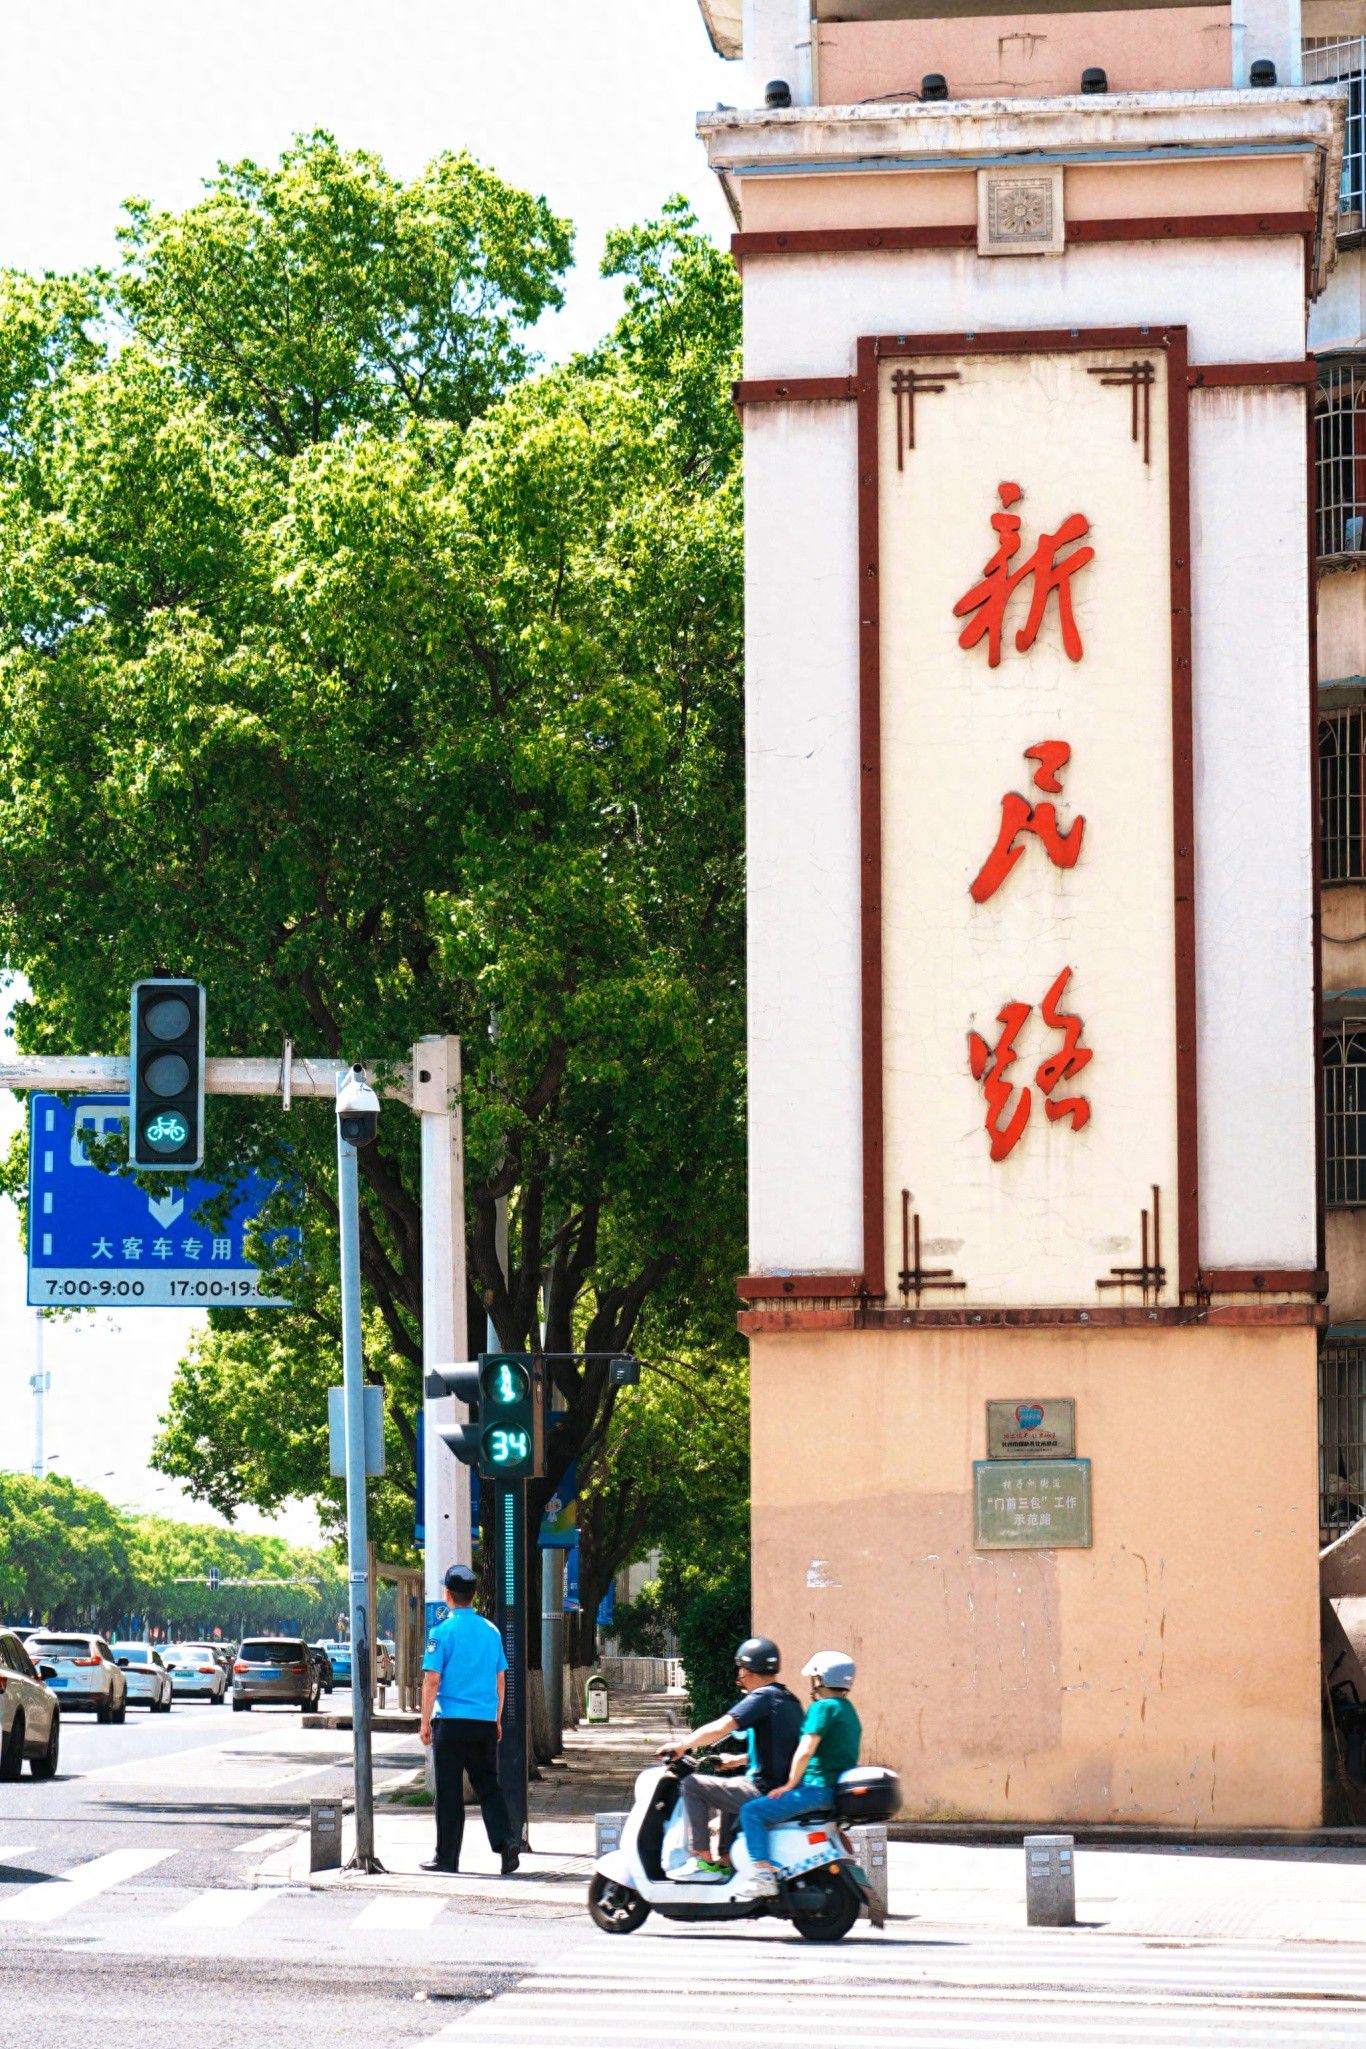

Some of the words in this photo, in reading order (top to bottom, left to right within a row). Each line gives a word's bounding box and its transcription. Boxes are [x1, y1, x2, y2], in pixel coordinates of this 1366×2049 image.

[953, 482, 1095, 1162] 新民路
[91, 1236, 252, 1261] 大客车专用
[45, 1280, 146, 1297] 7:00-9:00
[169, 1281, 281, 1297] 17:00-19:
[491, 1430, 527, 1462] 34
[1014, 1512, 1051, 1527] 示范路
